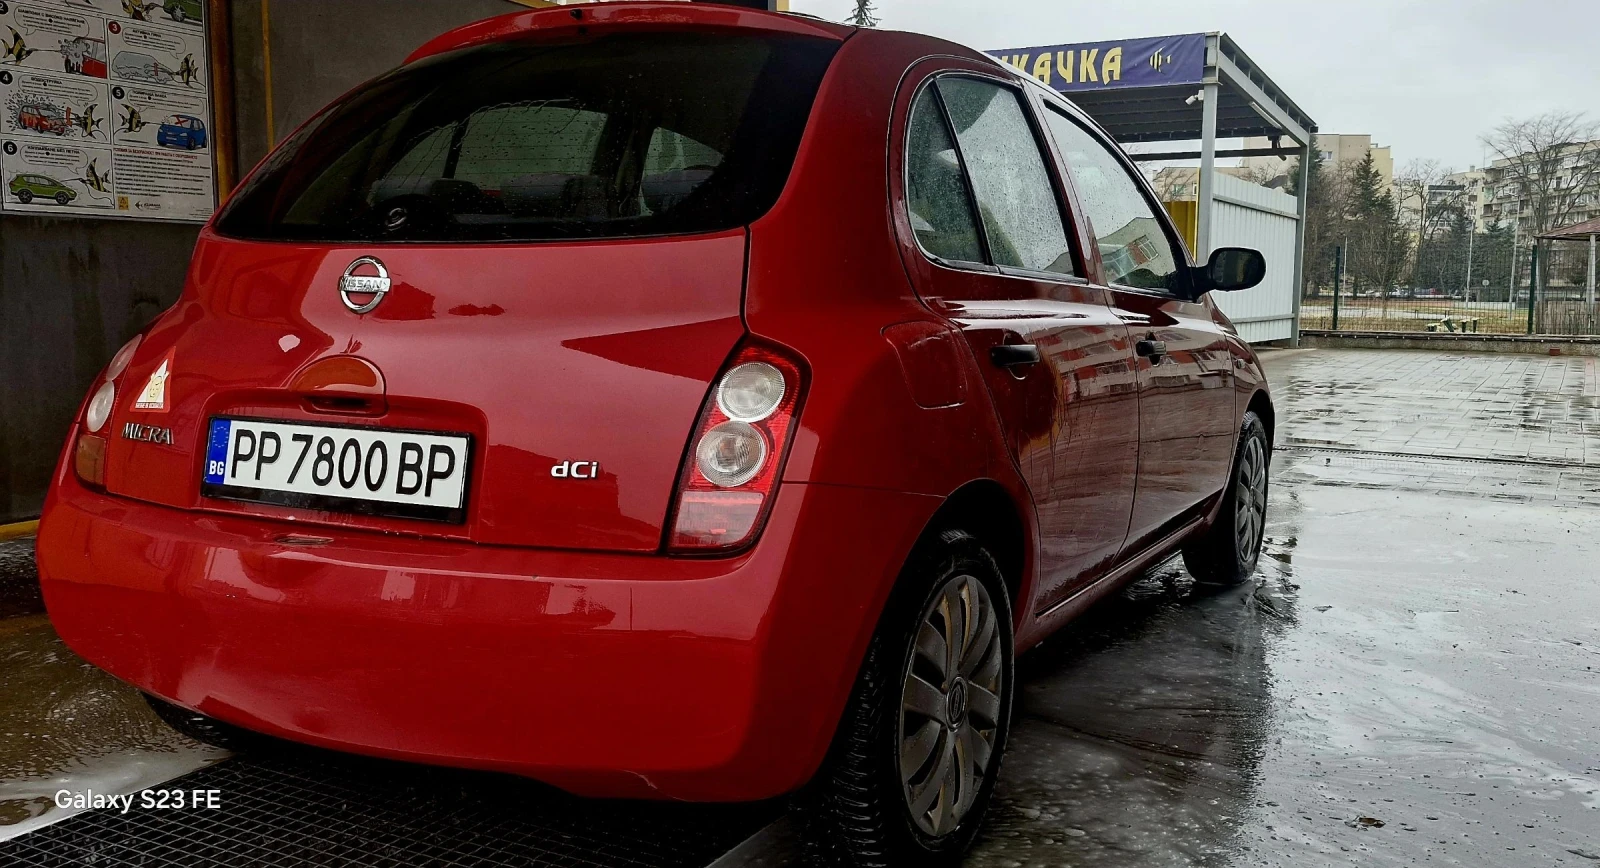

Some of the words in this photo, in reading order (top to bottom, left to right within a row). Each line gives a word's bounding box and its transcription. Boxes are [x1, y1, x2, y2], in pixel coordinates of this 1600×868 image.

[112, 24, 118, 32] 3
[2, 73, 9, 82] 4
[7, 144, 13, 152] 6
[341, 278, 382, 289] NISSAN
[122, 422, 174, 444] MICRA
[209, 460, 225, 476] BG
[230, 428, 281, 481] PP
[286, 433, 388, 492] 7800
[395, 442, 456, 498] BP
[550, 460, 598, 479] dCi
